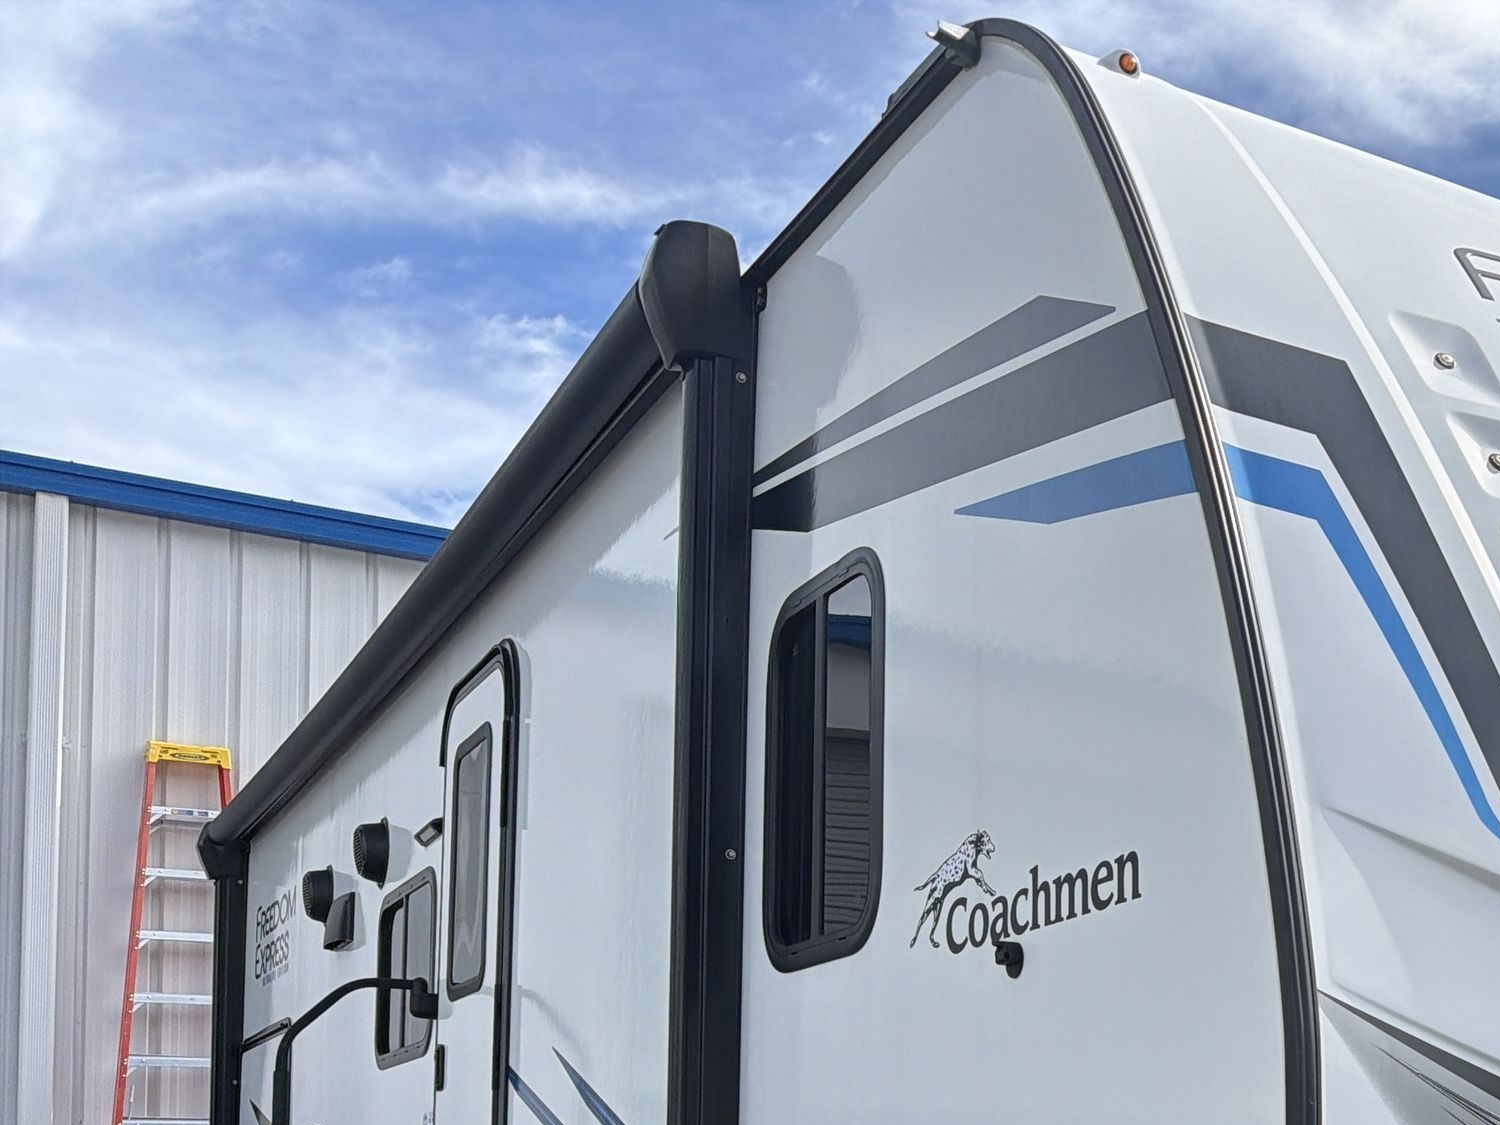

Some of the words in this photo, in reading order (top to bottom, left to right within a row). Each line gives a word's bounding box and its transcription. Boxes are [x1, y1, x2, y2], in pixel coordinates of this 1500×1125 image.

[256, 884, 297, 944] FREEDOM
[945, 850, 1142, 955] Coachmen
[255, 930, 290, 980] EXPRESS
